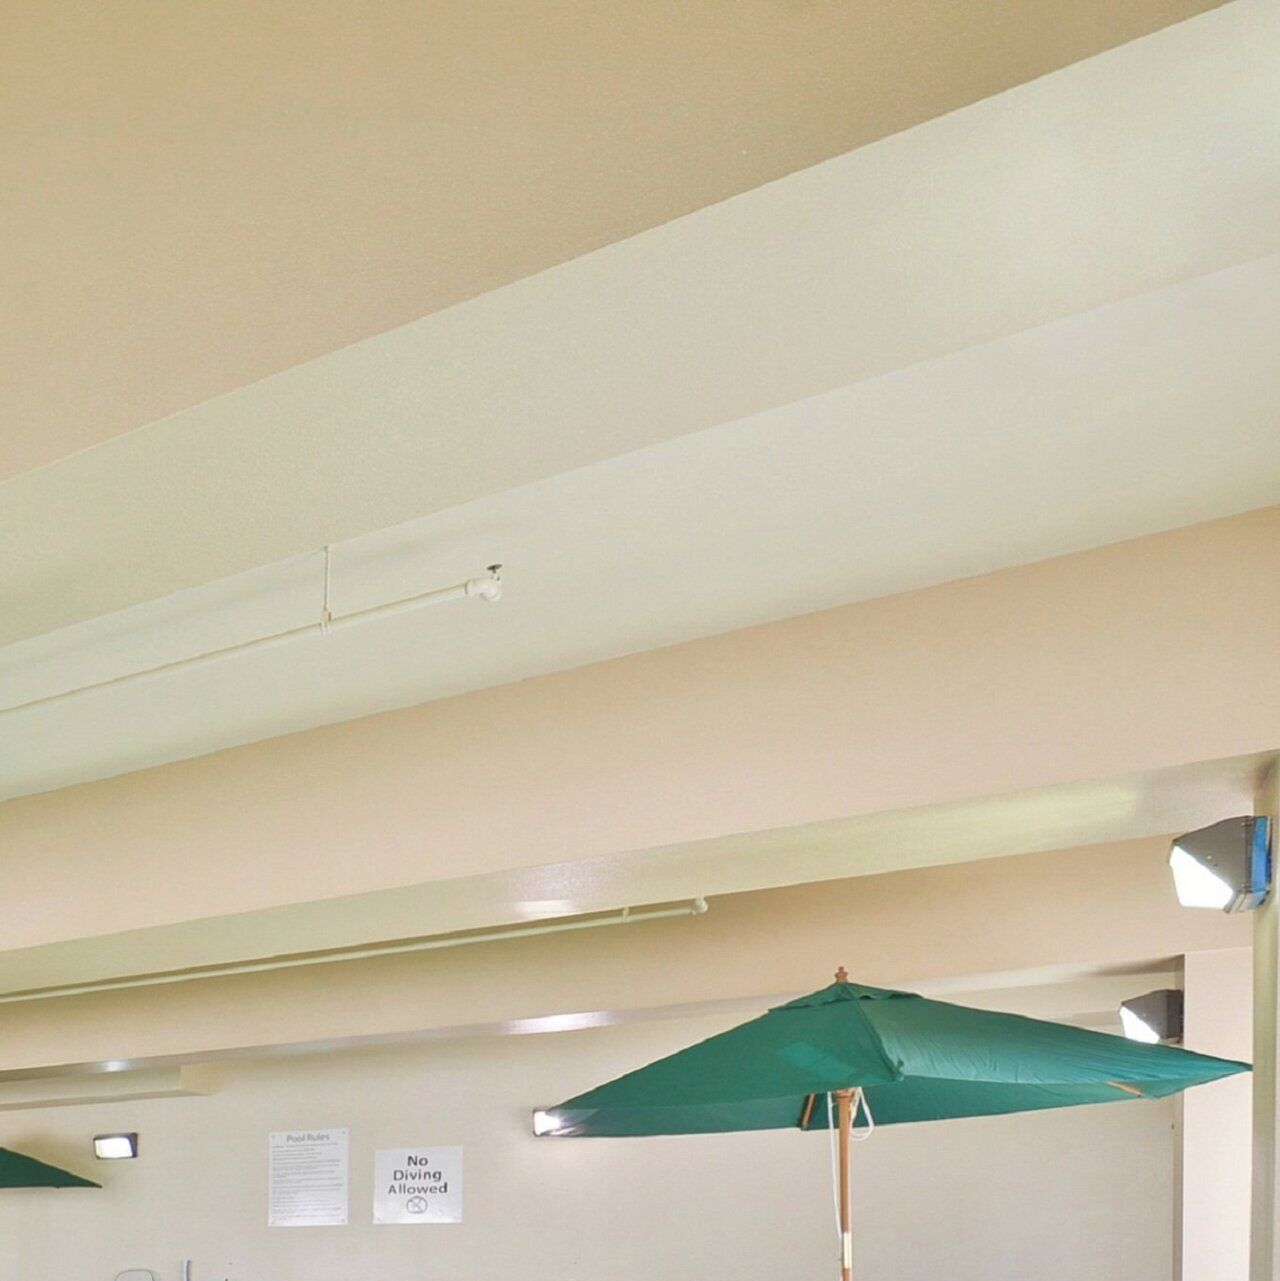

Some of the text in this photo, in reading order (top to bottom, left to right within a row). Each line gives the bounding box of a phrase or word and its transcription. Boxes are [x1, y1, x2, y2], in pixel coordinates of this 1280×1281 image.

[286, 1132, 330, 1143] Pool Rules
[407, 1155, 428, 1166] No
[393, 1169, 442, 1182] Diving
[388, 1182, 448, 1194] Allowed
